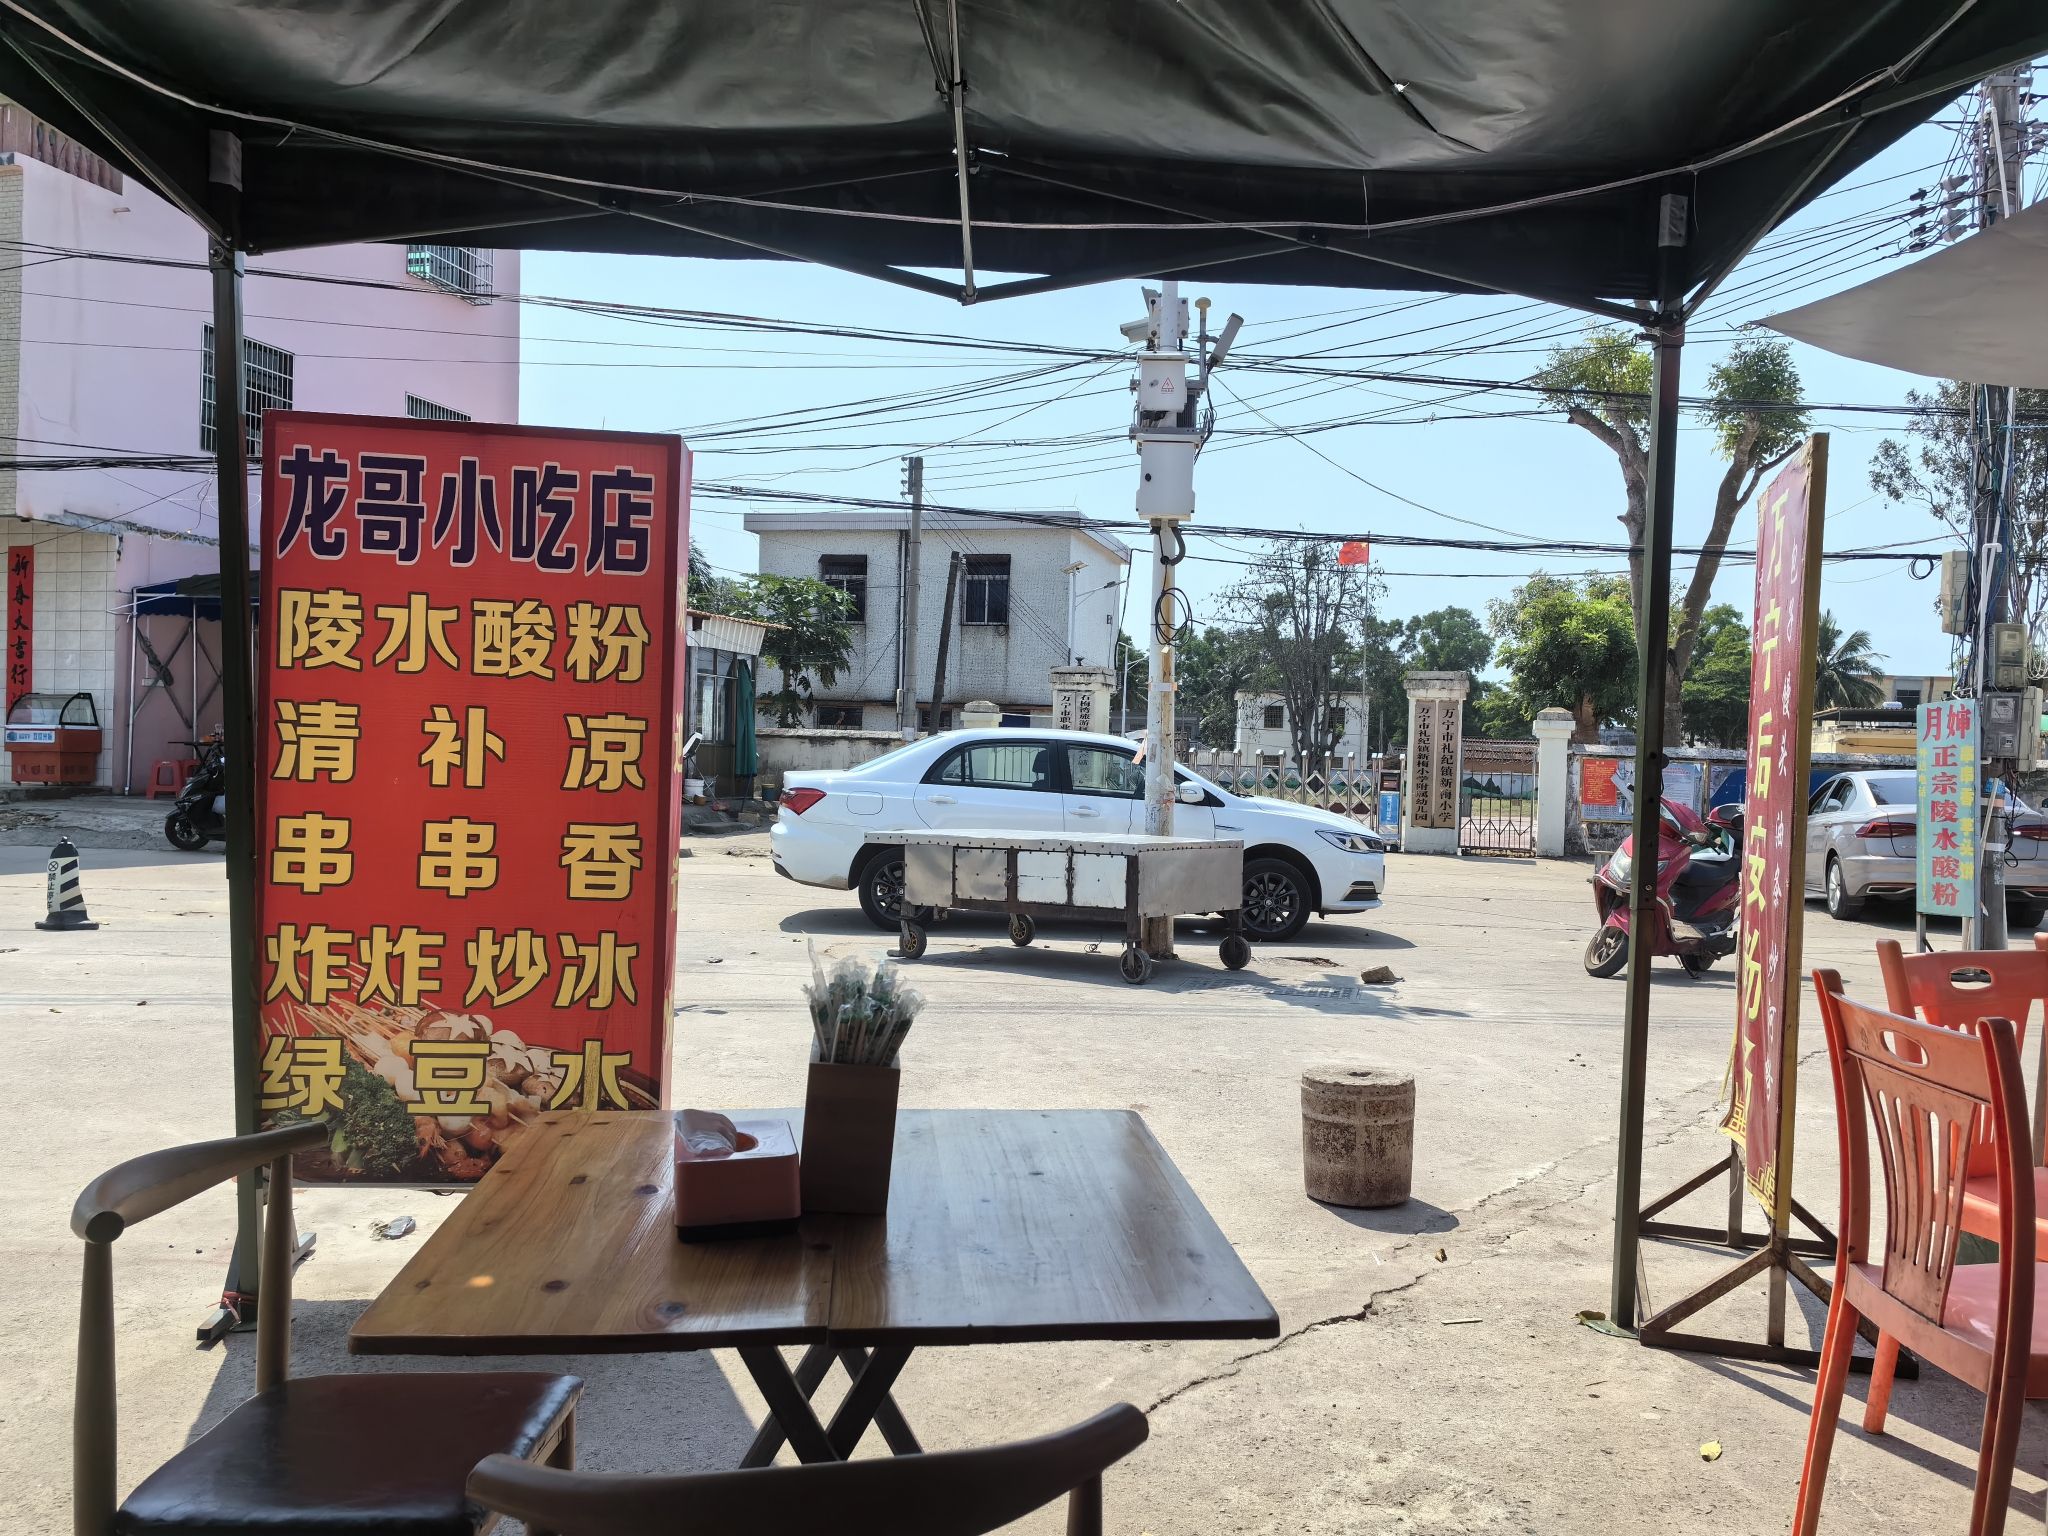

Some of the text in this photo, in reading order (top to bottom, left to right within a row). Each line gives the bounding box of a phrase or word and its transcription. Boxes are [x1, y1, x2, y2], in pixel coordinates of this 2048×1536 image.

[275, 445, 655, 577] 龙哥小吃店
[276, 588, 651, 684] 陵水酸粉
[273, 699, 648, 793] 清补凉
[270, 811, 643, 901] 串串香
[1930, 744, 1961, 907] 正宗陵水酸粉
[266, 923, 638, 1010] 炸炸炒冰
[259, 1034, 630, 1117] 绿豆水
